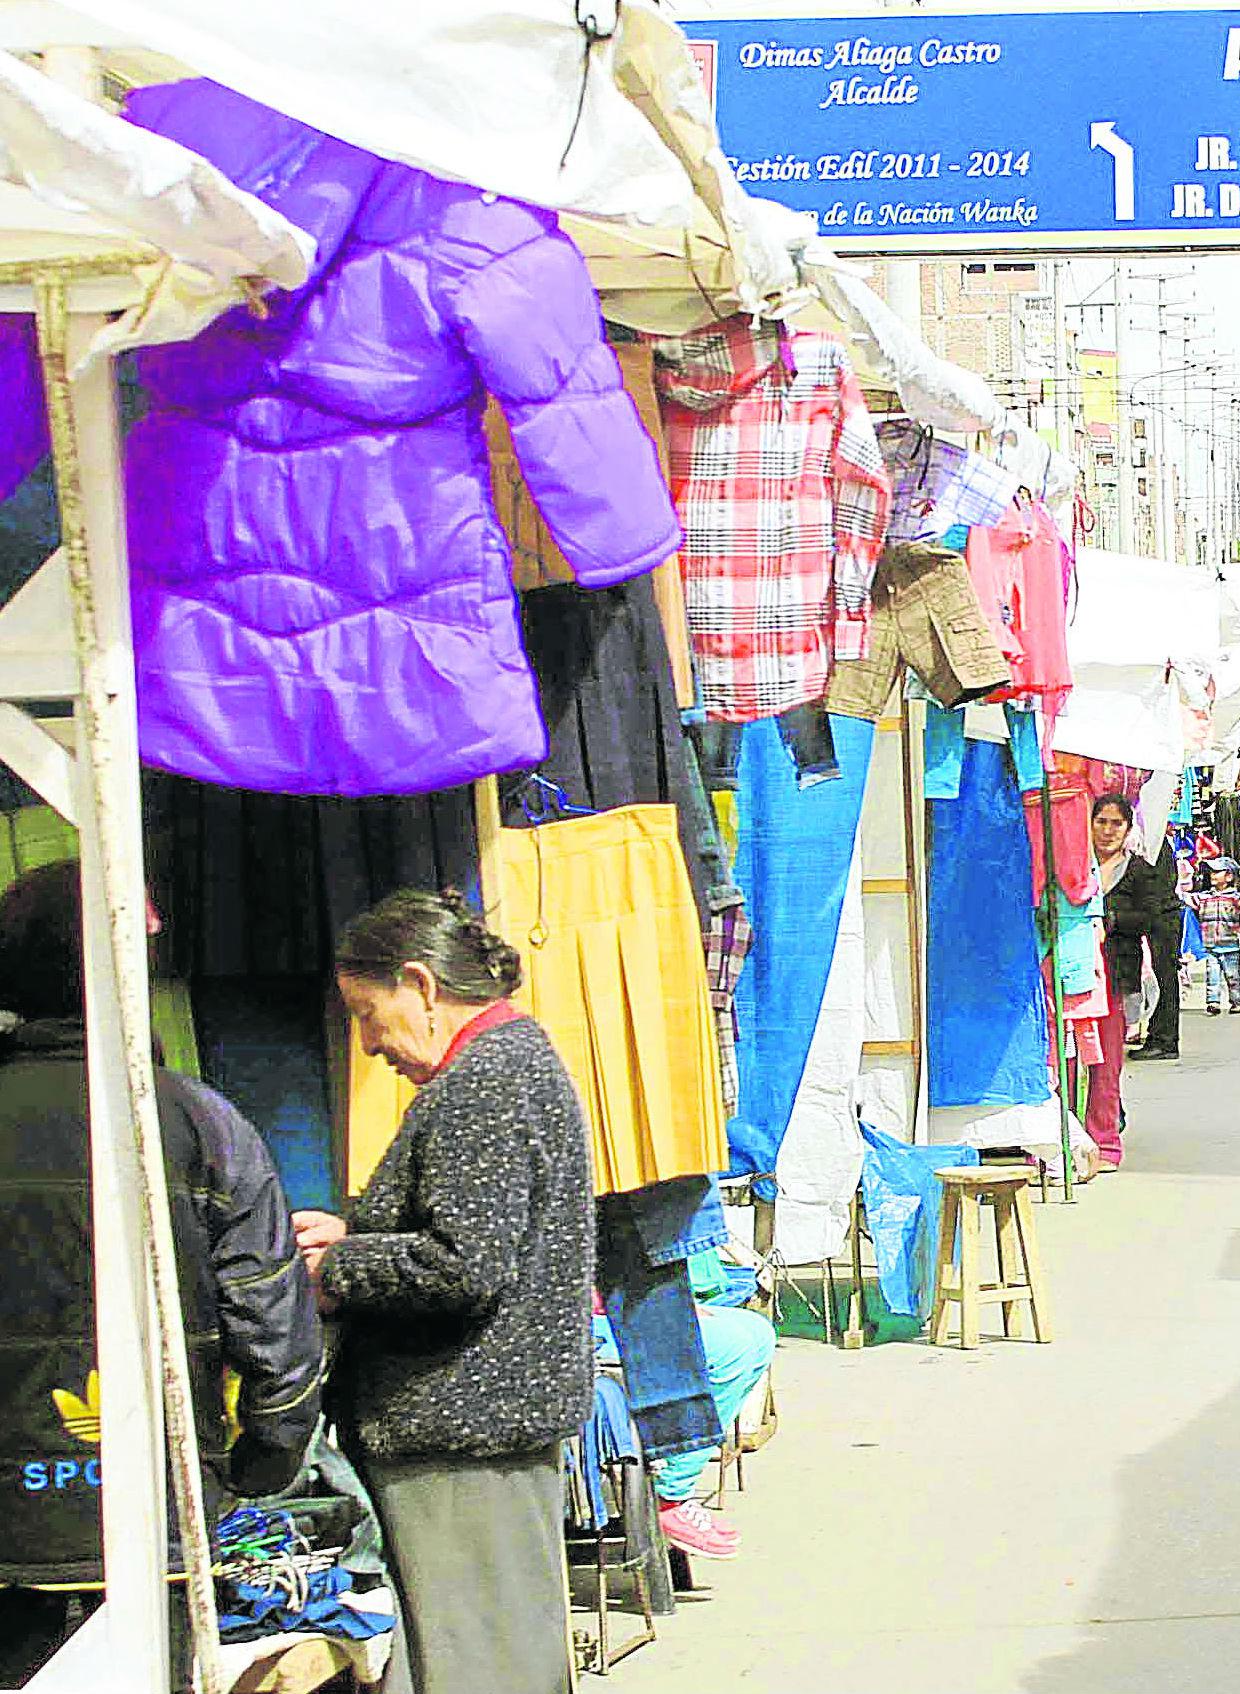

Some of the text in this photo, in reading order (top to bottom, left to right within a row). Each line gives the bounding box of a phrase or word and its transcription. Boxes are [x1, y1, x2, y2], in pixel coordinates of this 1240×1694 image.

[739, 38, 823, 69] Dimas
[825, 37, 912, 74] Aliaga
[919, 40, 1001, 67] Castro
[818, 75, 919, 109] Alcalde
[816, 150, 880, 180] Edil
[878, 152, 941, 179] 2011
[966, 151, 1030, 177] 2014
[1195, 136, 1238, 171] JR.
[823, 201, 848, 226] de
[853, 201, 874, 225] la
[877, 201, 955, 226] Nación
[959, 197, 1038, 227] Wanka
[1170, 184, 1214, 218] JR.
